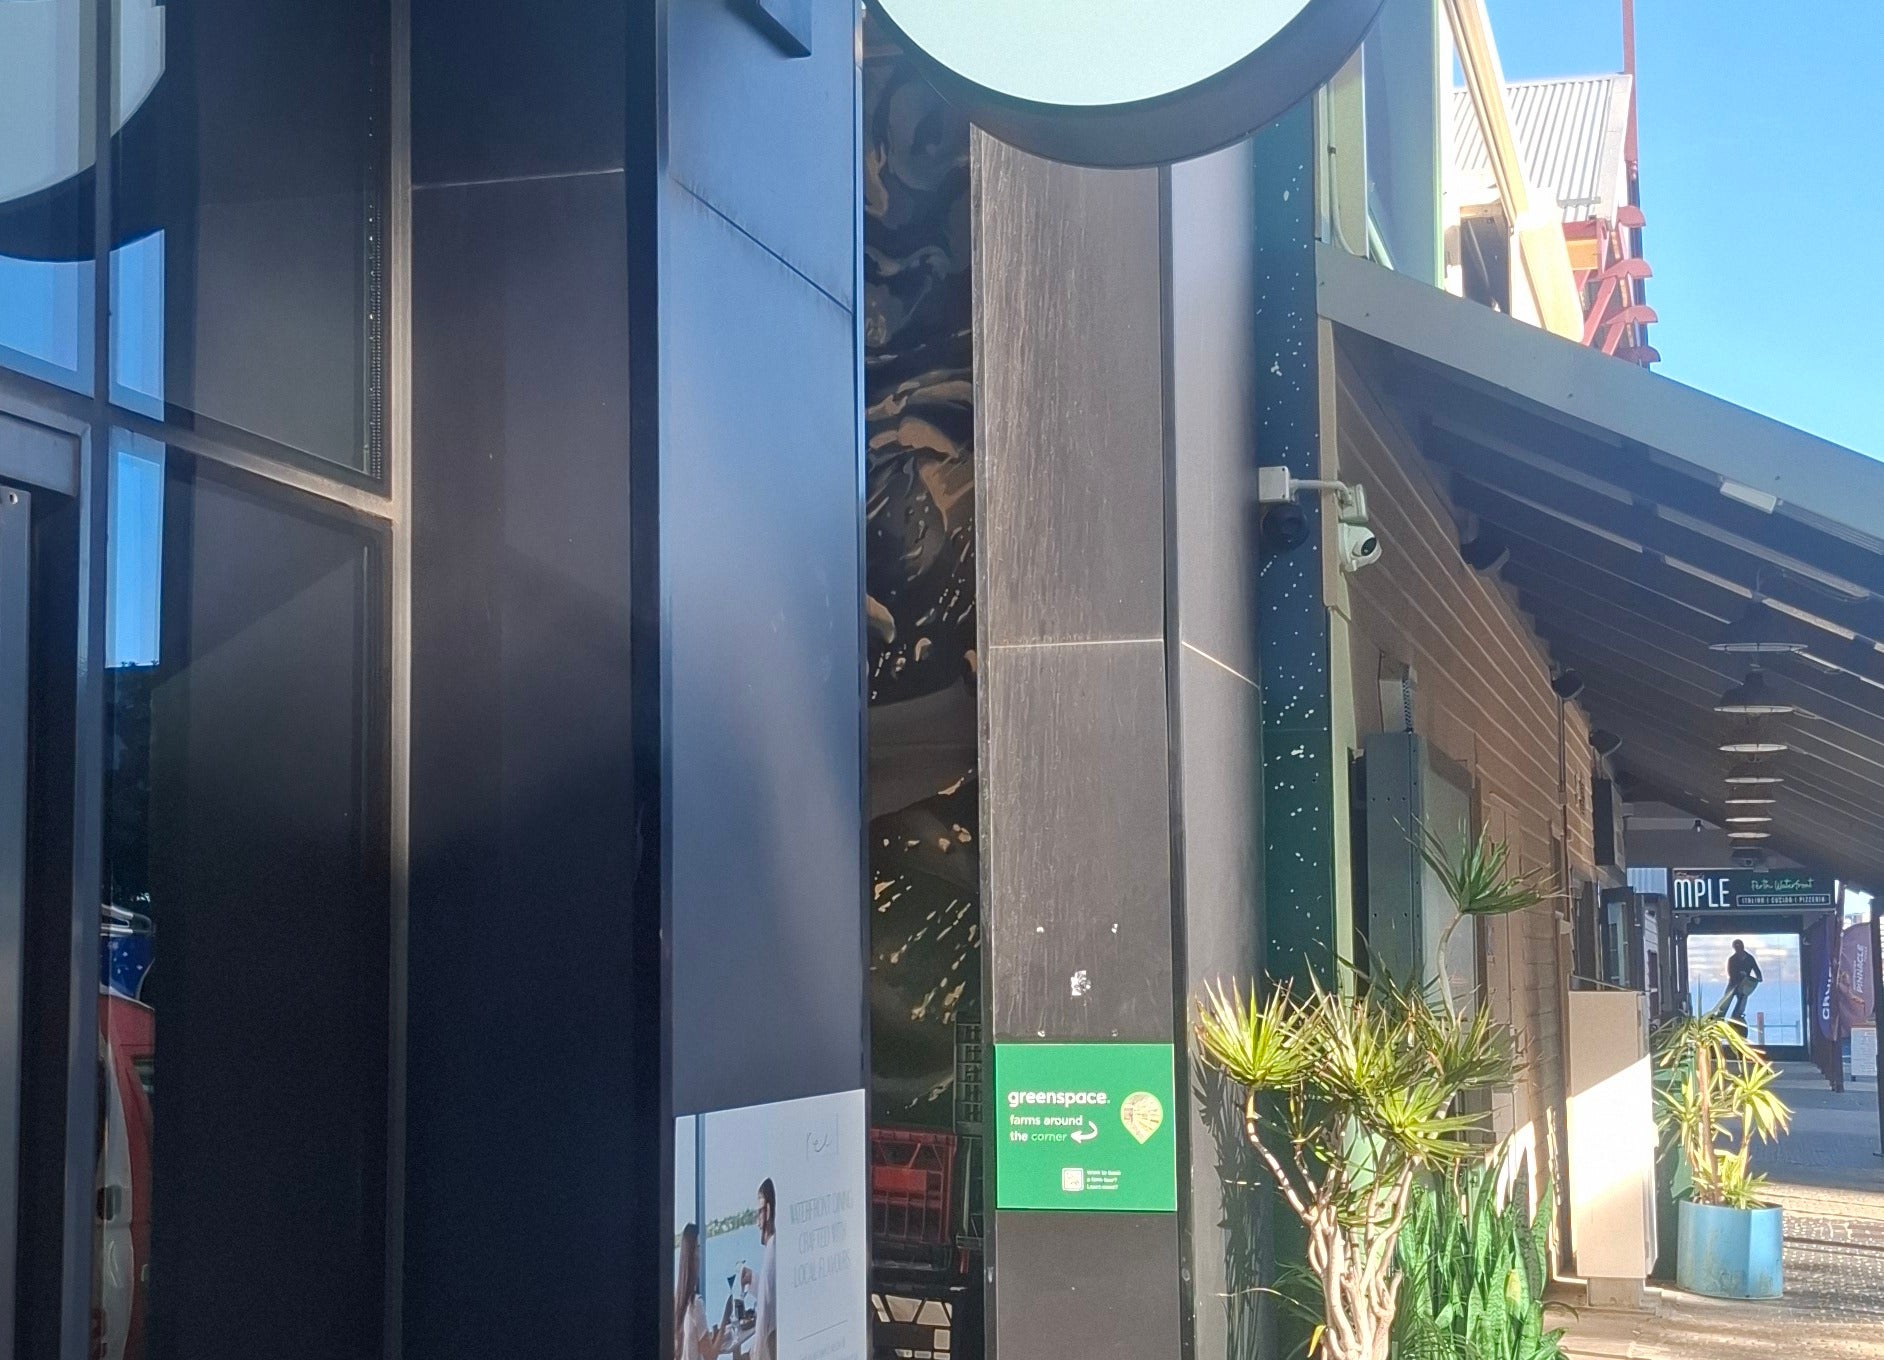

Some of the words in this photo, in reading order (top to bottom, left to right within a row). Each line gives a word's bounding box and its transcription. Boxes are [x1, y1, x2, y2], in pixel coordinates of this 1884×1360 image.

[1673, 877, 1731, 909] MPLE
[1856, 943, 1865, 994] PINNACLE
[1007, 1090, 1111, 1108] greenspace.
[1009, 1114, 1041, 1127] farms
[1043, 1114, 1084, 1127] around
[1009, 1130, 1028, 1143] the
[1031, 1131, 1067, 1143] corner
